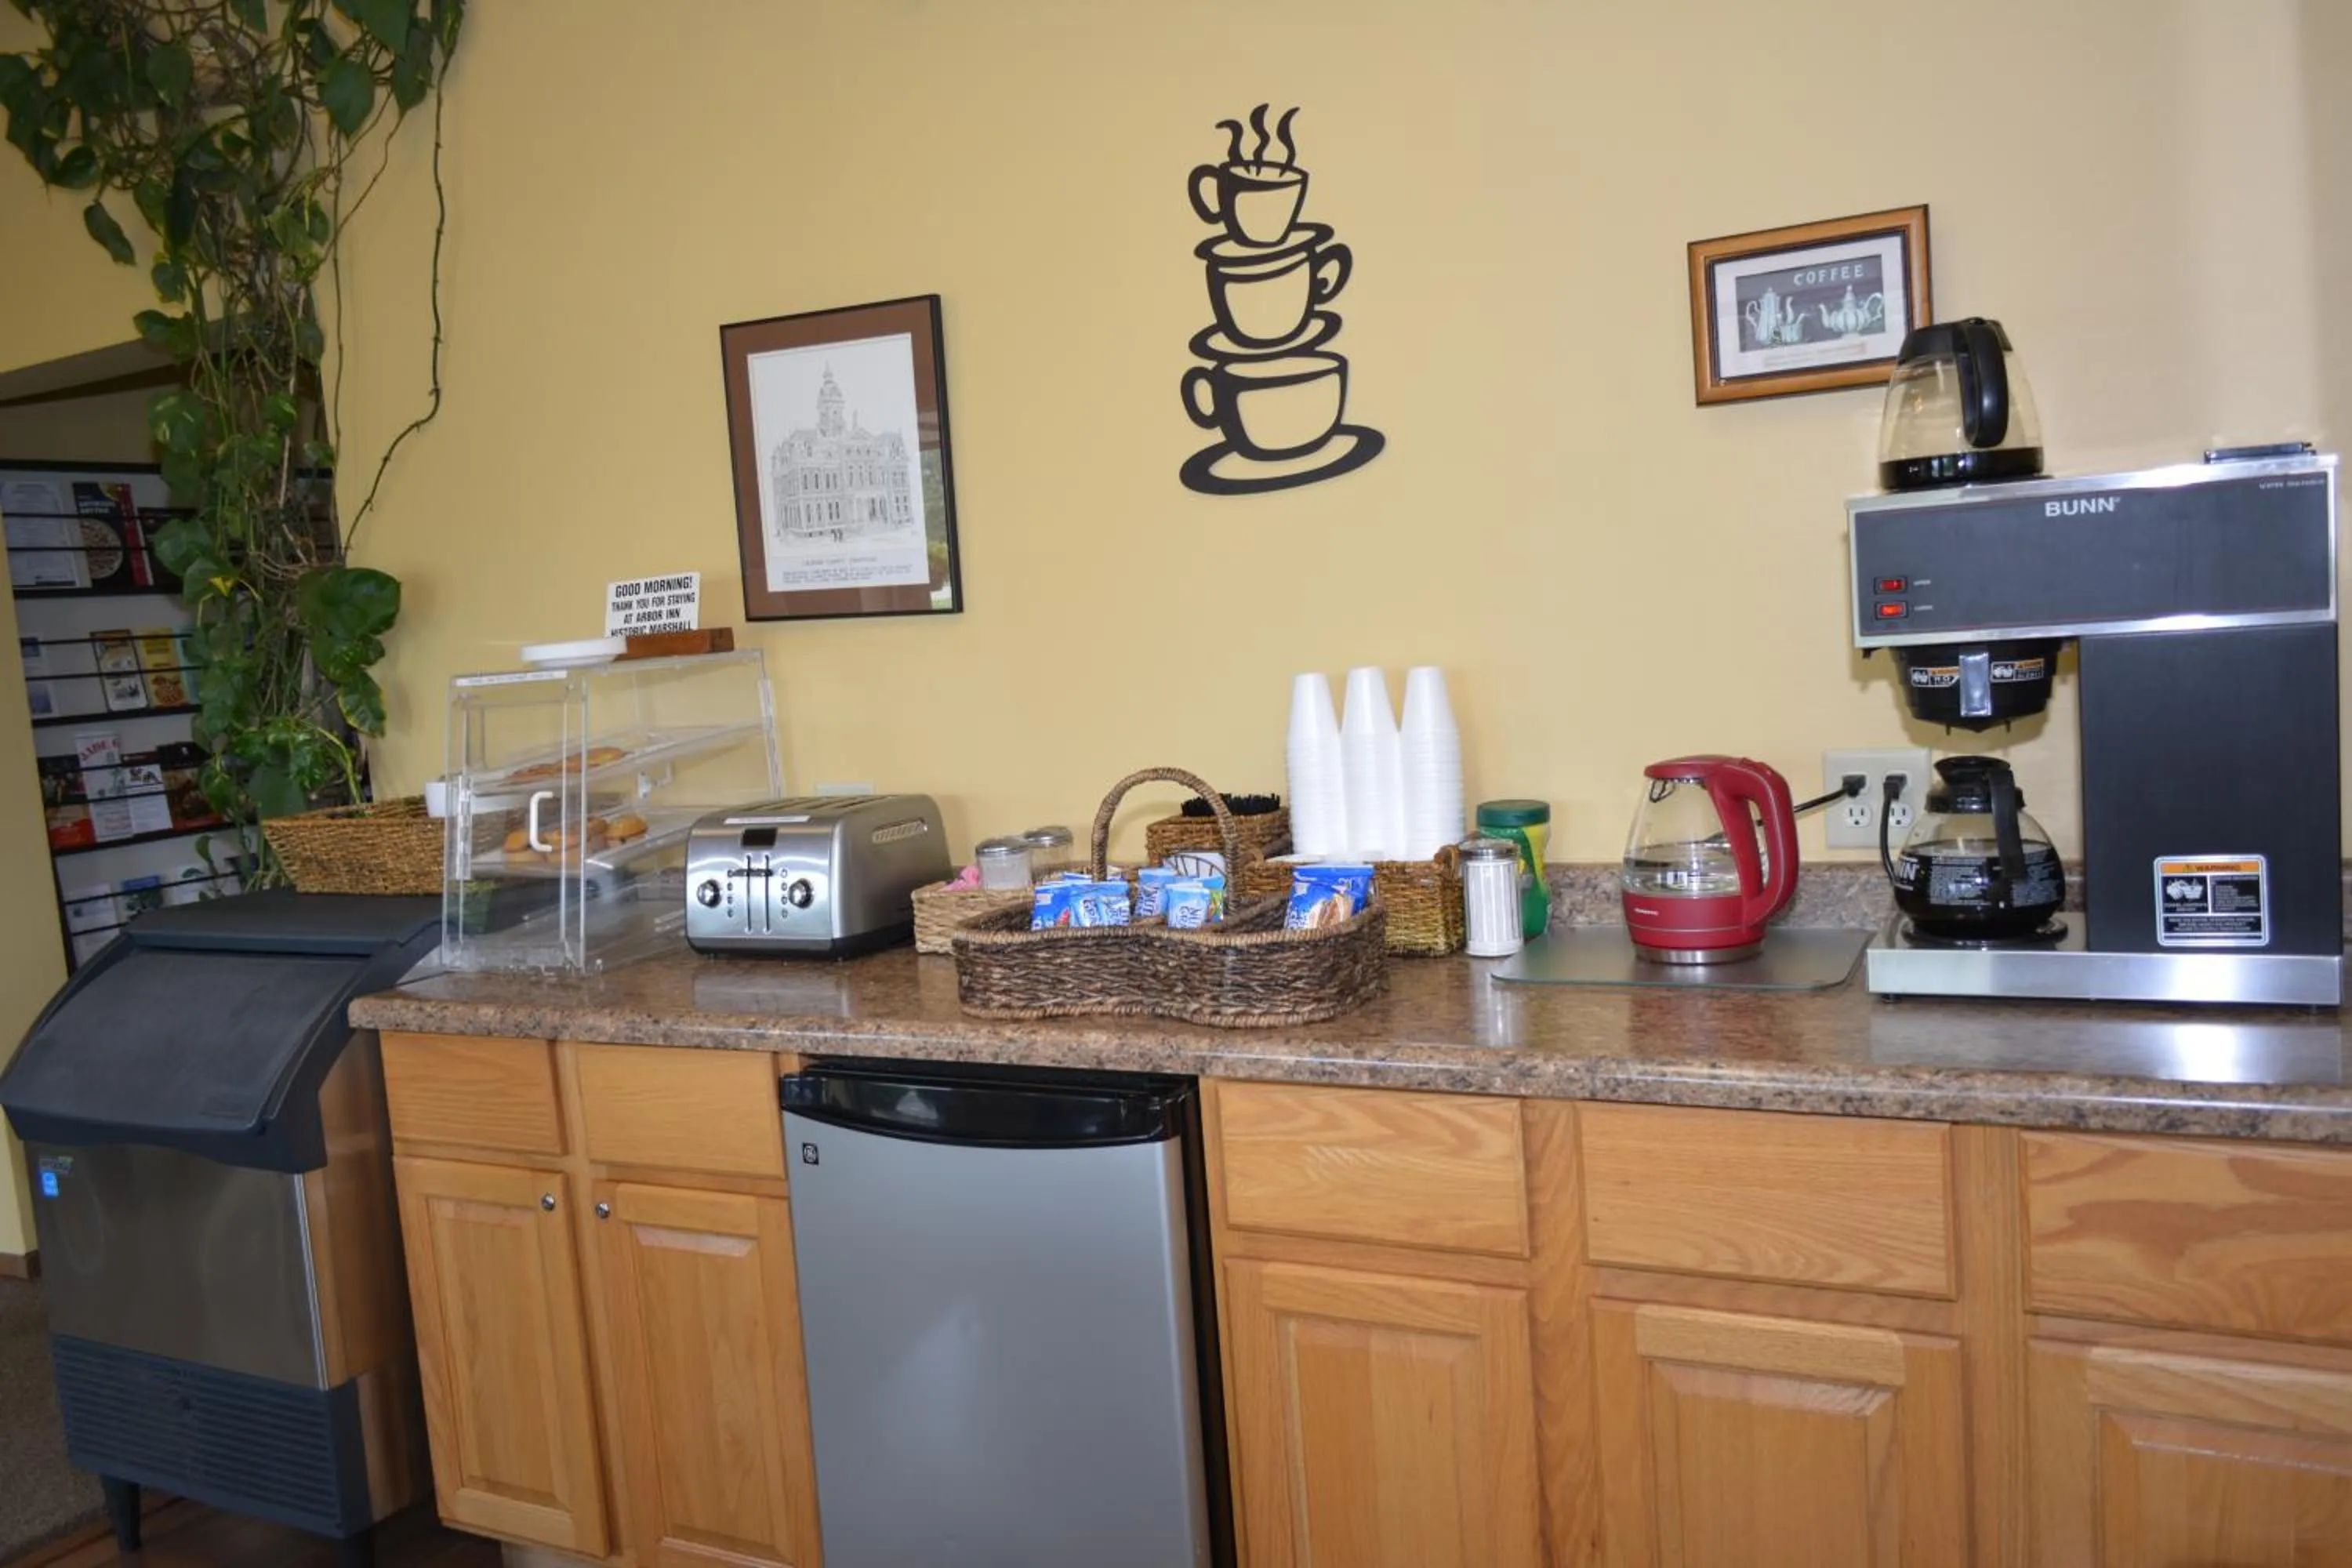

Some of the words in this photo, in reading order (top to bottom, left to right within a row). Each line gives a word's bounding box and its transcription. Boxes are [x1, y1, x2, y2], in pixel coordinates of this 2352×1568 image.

[1793, 264, 1864, 285] COFFEE
[2044, 496, 2114, 517] BUNN
[615, 583, 641, 598] GOOD
[644, 576, 693, 593] MORNING!
[612, 601, 633, 612] THANK
[636, 598, 649, 609] YOU
[652, 596, 666, 607] FOR
[667, 592, 695, 606] STAYING
[623, 613, 633, 625] AT
[636, 610, 662, 624] ARBOR
[666, 608, 681, 619] INN
